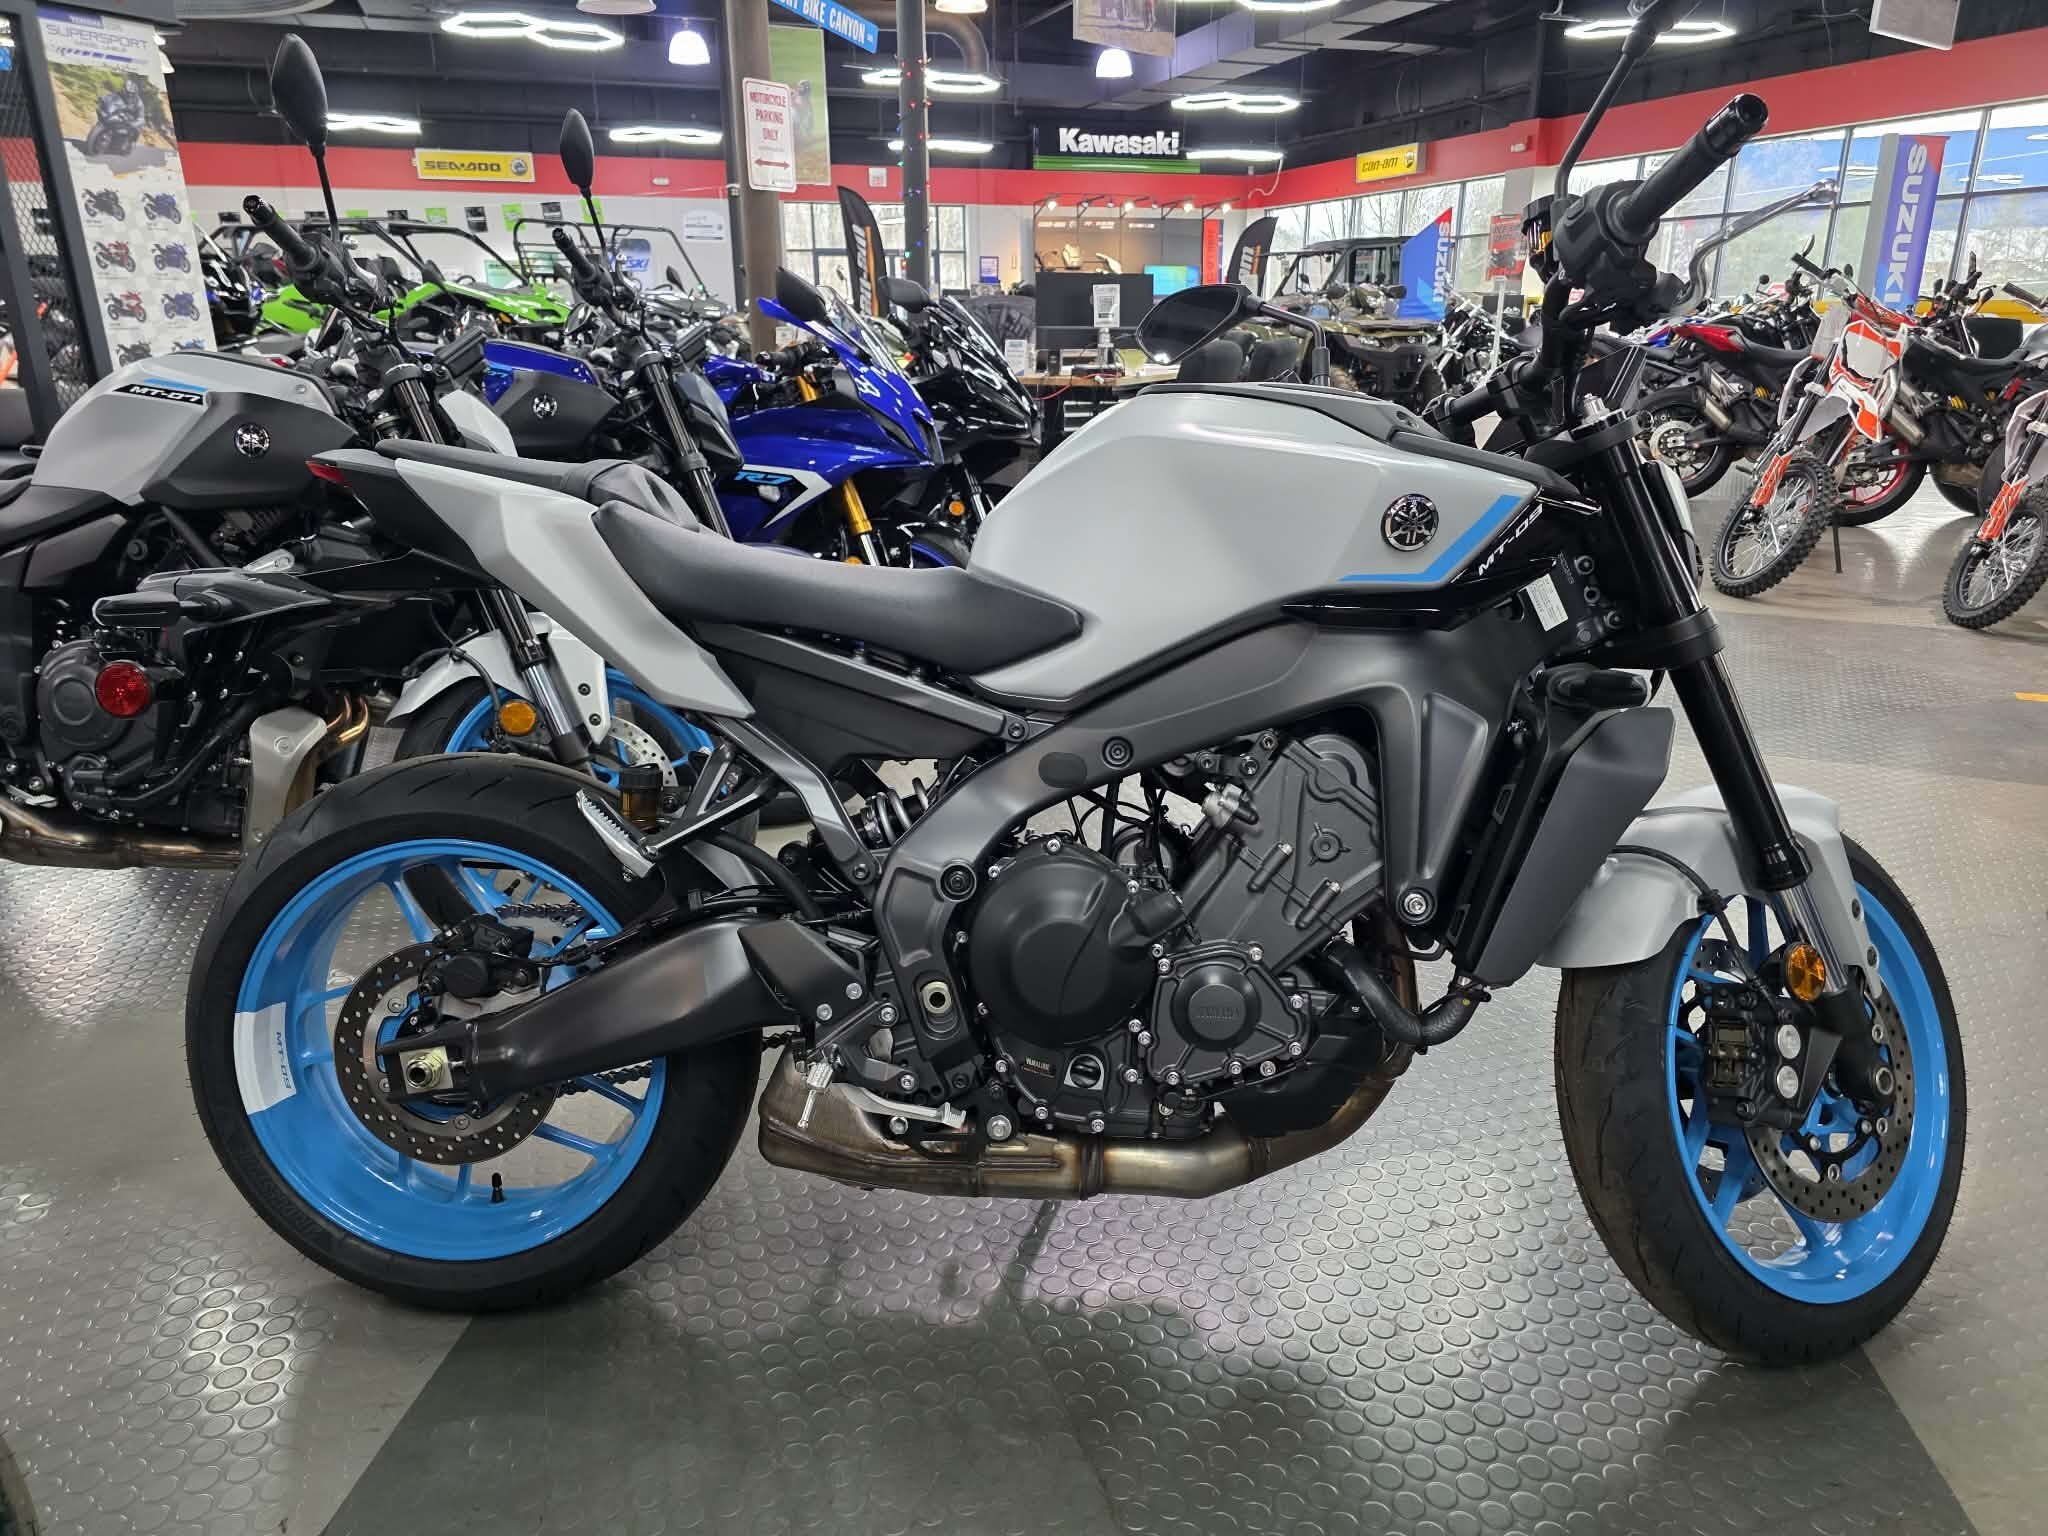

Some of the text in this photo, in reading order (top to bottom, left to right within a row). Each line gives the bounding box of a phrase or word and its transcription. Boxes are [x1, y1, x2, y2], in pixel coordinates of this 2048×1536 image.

[802, 0, 866, 44] BIKE CANYON
[46, 24, 147, 49] SUPERSPORT
[750, 91, 786, 107] MOTORCYCLE
[755, 108, 784, 124] PARKING
[762, 127, 779, 141] ONLY
[1058, 127, 1180, 155] Kawasaki
[1884, 143, 1928, 303] SUZUKI
[1431, 221, 1450, 302] SUZUKI
[129, 386, 201, 402] MT-07
[1478, 503, 1543, 576] MT-09
[275, 1031, 292, 1089] MT-09
